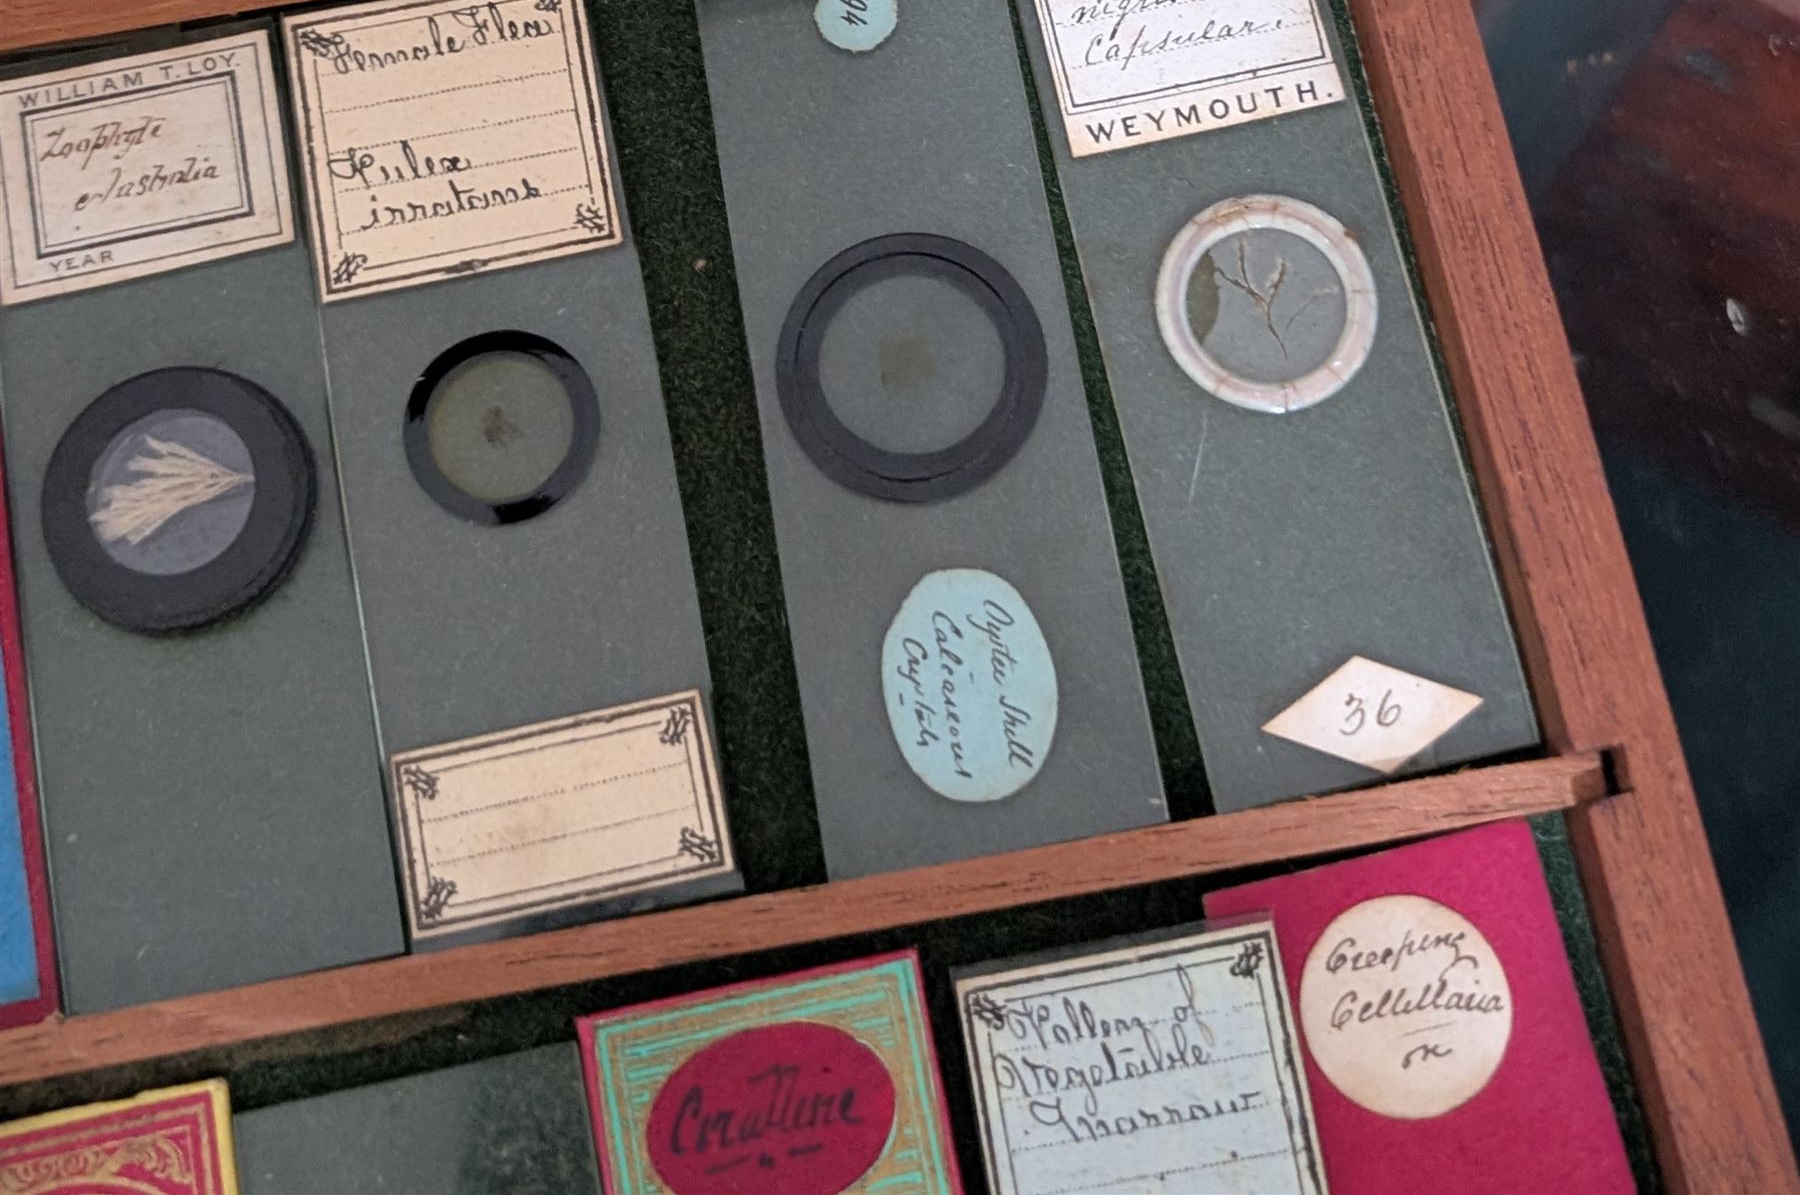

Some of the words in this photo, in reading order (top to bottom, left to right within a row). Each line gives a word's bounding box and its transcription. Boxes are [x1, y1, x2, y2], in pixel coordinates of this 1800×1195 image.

[19, 71, 144, 109] WILLIAM
[1086, 81, 1333, 144] WEYMOUTH.
[50, 250, 114, 273] YEAR
[1339, 689, 1402, 736] 36
